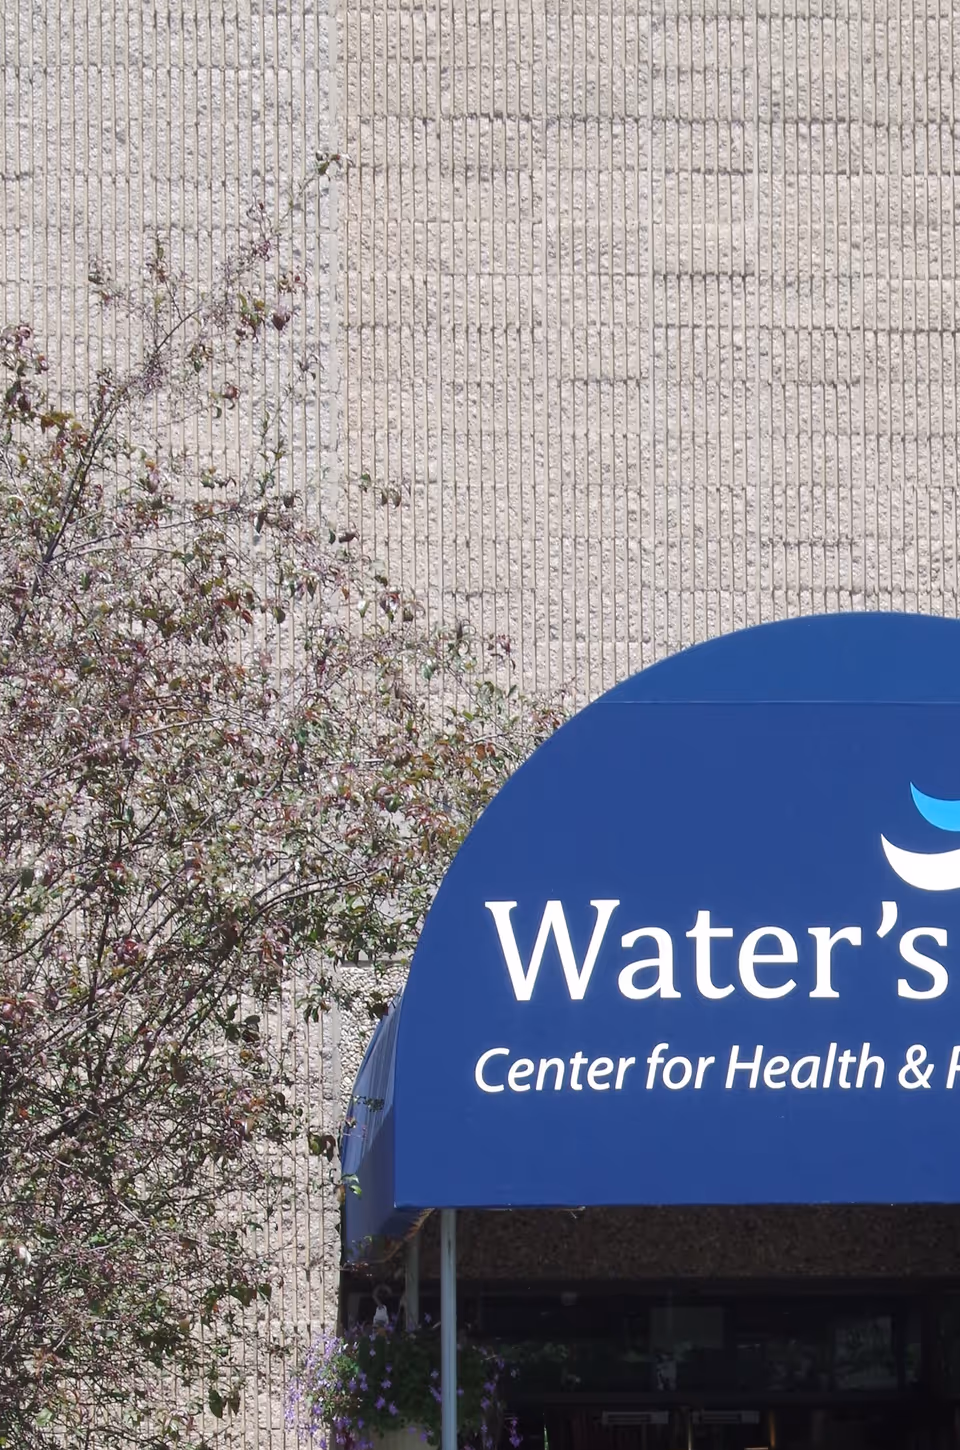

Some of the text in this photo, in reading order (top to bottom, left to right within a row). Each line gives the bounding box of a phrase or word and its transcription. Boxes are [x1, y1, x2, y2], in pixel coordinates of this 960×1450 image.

[484, 897, 949, 1003] Water's
[474, 1047, 636, 1093] Center
[644, 1042, 716, 1090] for
[725, 1042, 885, 1090] Health
[897, 1044, 936, 1090] &
